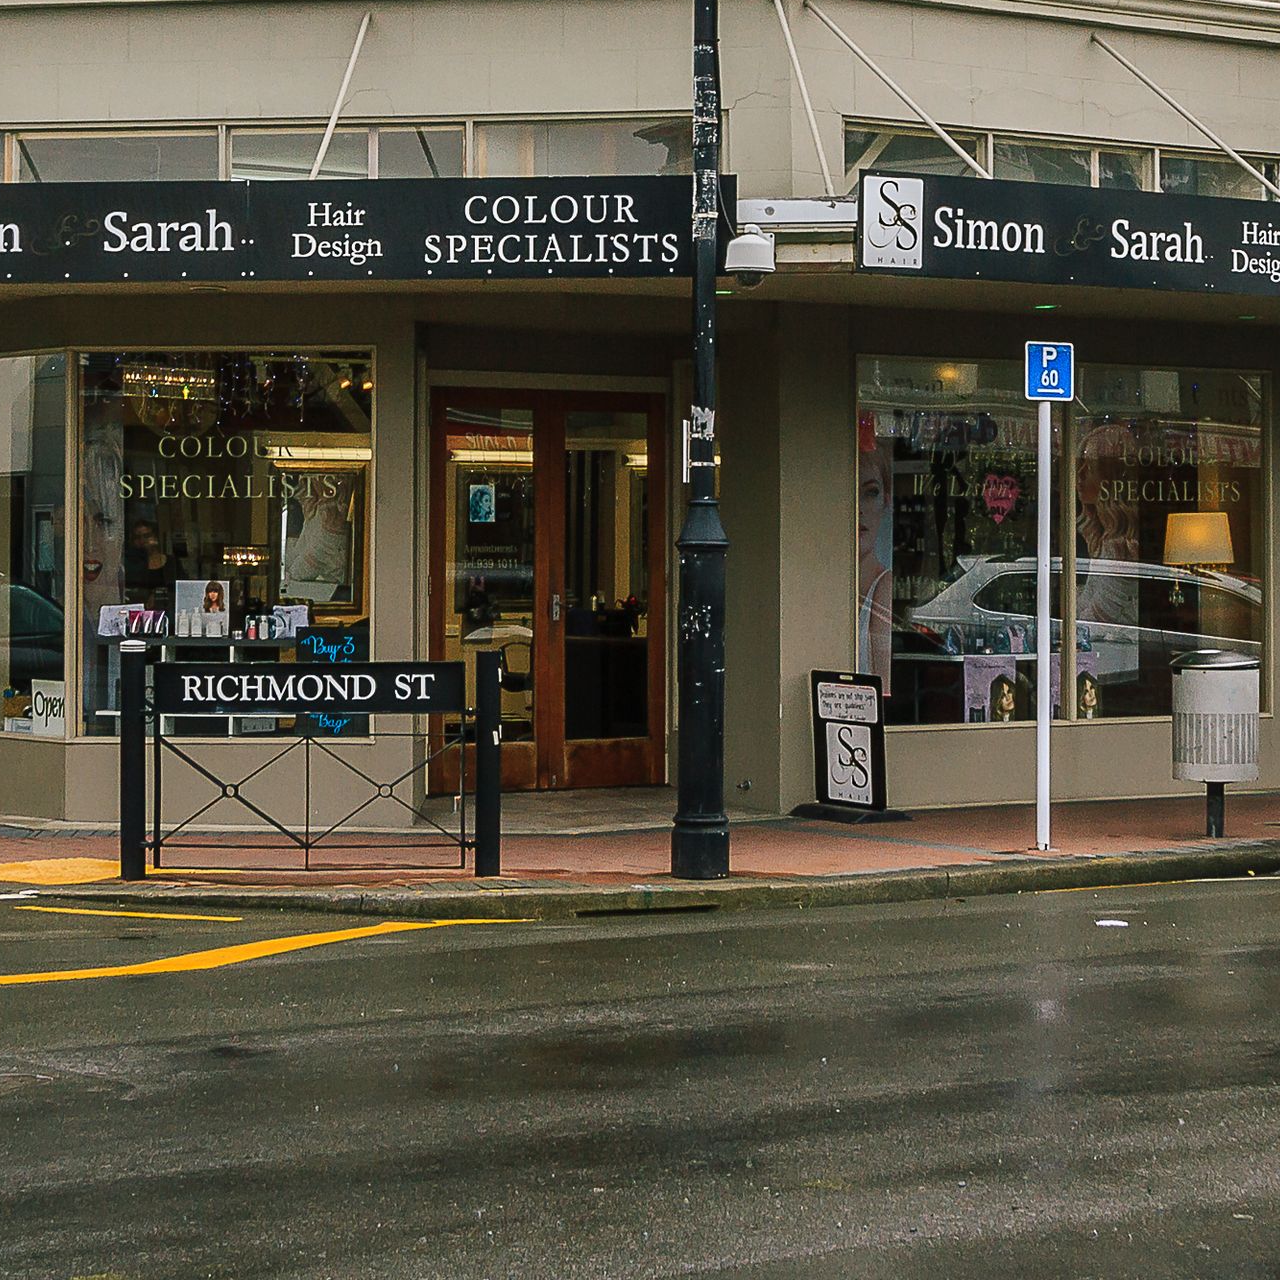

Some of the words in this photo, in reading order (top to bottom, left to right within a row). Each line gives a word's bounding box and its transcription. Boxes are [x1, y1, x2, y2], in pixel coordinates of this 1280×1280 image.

[308, 202, 366, 228] Hair
[464, 194, 639, 225] COLOUR
[103, 209, 235, 253] Sarah
[933, 207, 1046, 254] Simon
[1110, 218, 1205, 264] Sarah
[291, 235, 384, 264] Design
[424, 233, 680, 264] SPECIALISTS
[877, 257, 918, 265] HAIR
[1042, 346, 1058, 368] P
[1041, 369, 1059, 387] 60
[158, 435, 293, 459] COLOUR
[1122, 445, 1218, 468] COLOU
[119, 474, 339, 500] SPECIALISTS
[1099, 479, 1241, 503] SPECIALISTS
[343, 636, 355, 655] 3
[181, 675, 377, 702] RICHMOND
[394, 673, 436, 701] ST
[34, 690, 65, 728] Open
